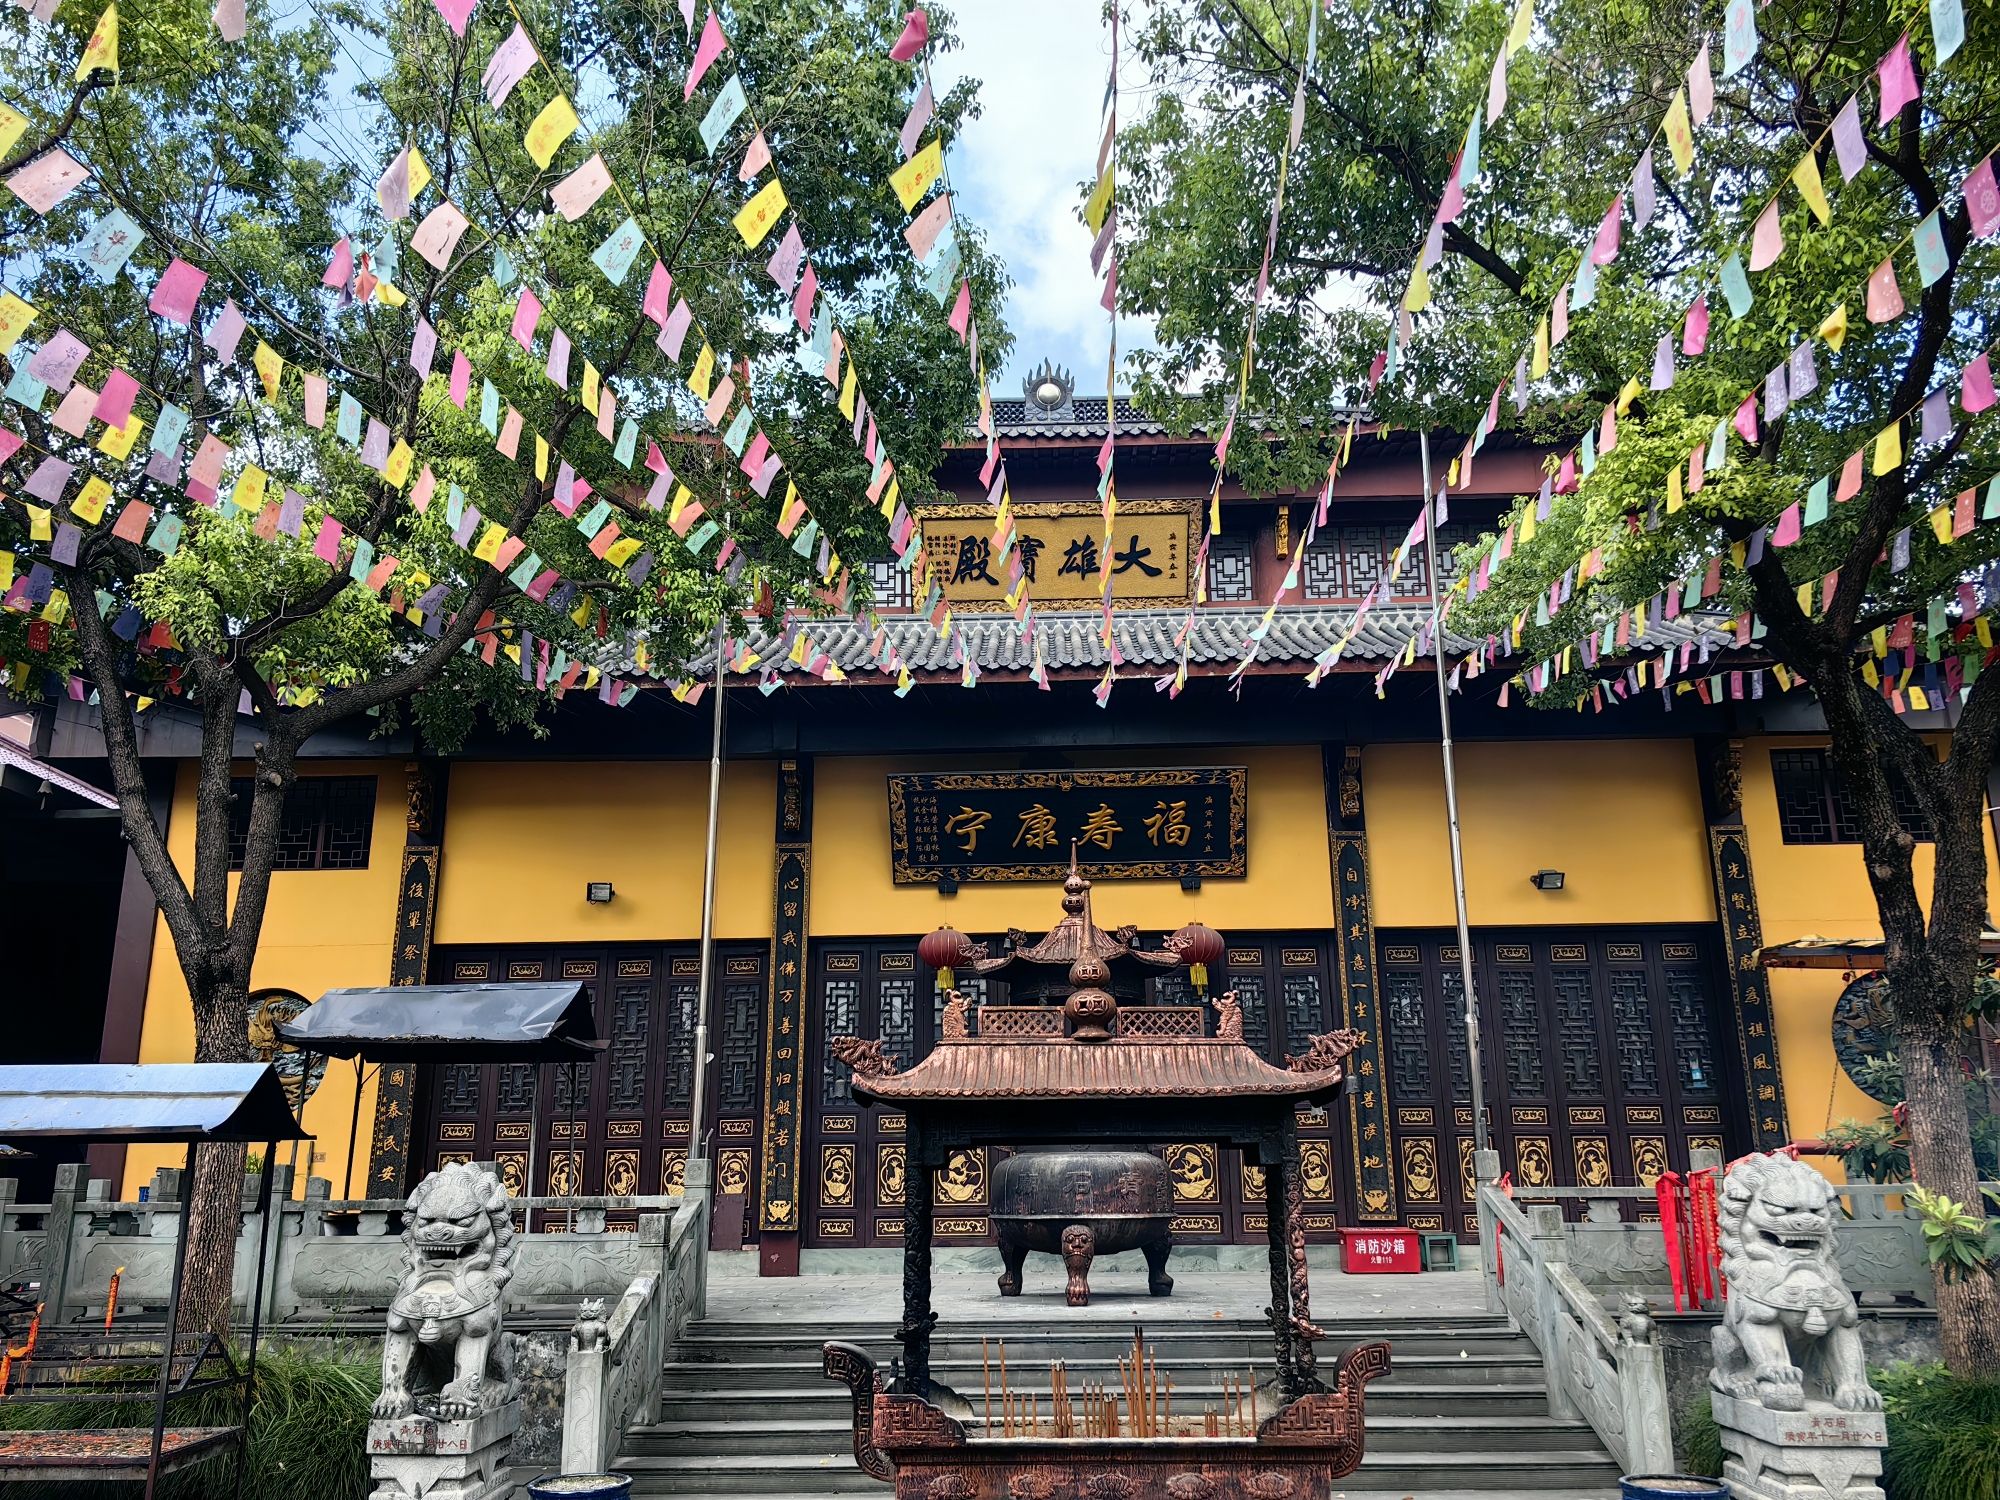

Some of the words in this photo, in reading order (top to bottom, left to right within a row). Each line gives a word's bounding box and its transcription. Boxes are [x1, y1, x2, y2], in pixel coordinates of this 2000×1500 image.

[944, 800, 1192, 851] 福寿康宁
[378, 1069, 405, 1182] 國泰民安
[1355, 1238, 1406, 1255] 消防沙箱
